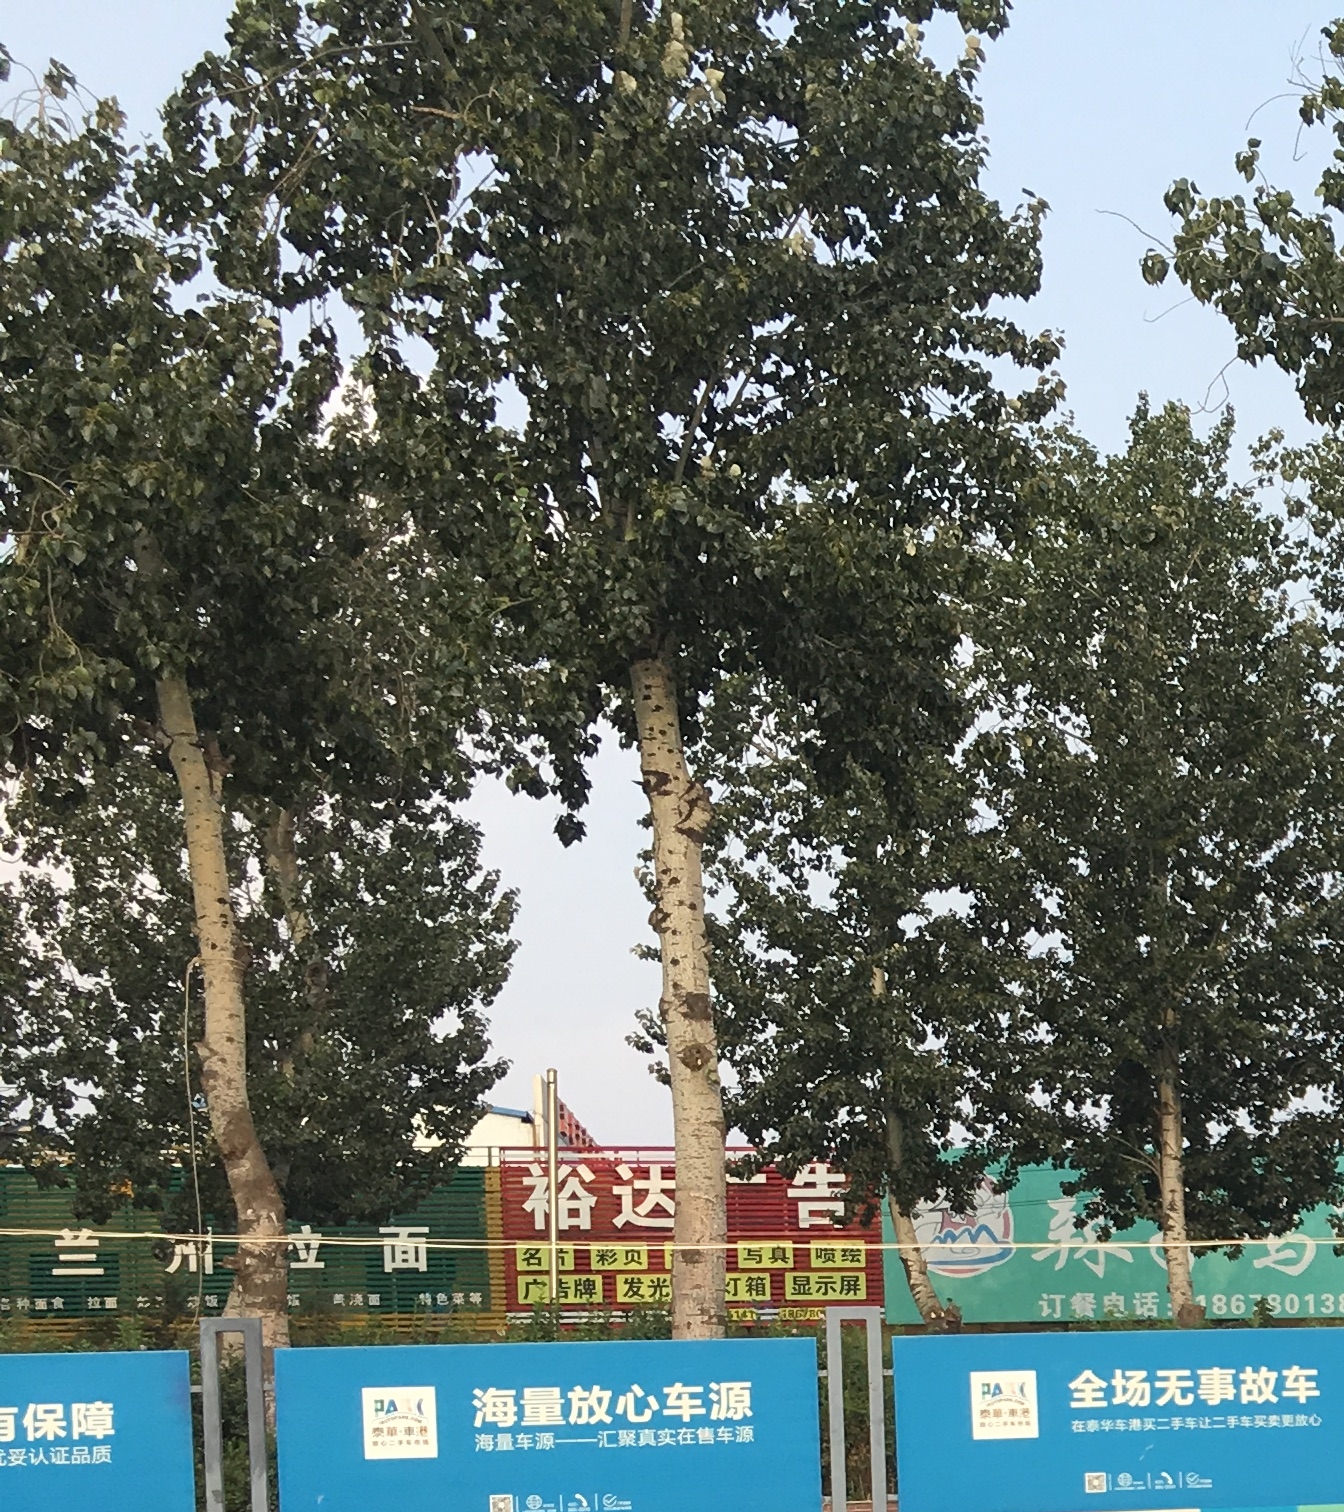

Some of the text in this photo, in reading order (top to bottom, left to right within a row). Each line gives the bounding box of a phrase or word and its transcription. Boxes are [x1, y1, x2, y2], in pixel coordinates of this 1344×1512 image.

[521, 1162, 851, 1231] 裕达告
[595, 1246, 644, 1267] 彩页
[743, 1244, 791, 1266] 写真
[814, 1242, 862, 1266] 喷绘
[522, 1277, 598, 1300] 广告牌
[789, 1274, 862, 1298] 显示屏
[1068, 1365, 1321, 1409] 全场无事故车
[471, 1381, 754, 1429] 海量放心车源
[1071, 1413, 1323, 1434] 在泰华车港买二手车让二手车买卖更放心
[474, 1425, 756, 1453] 海量车源——汇聚真实在售车源
